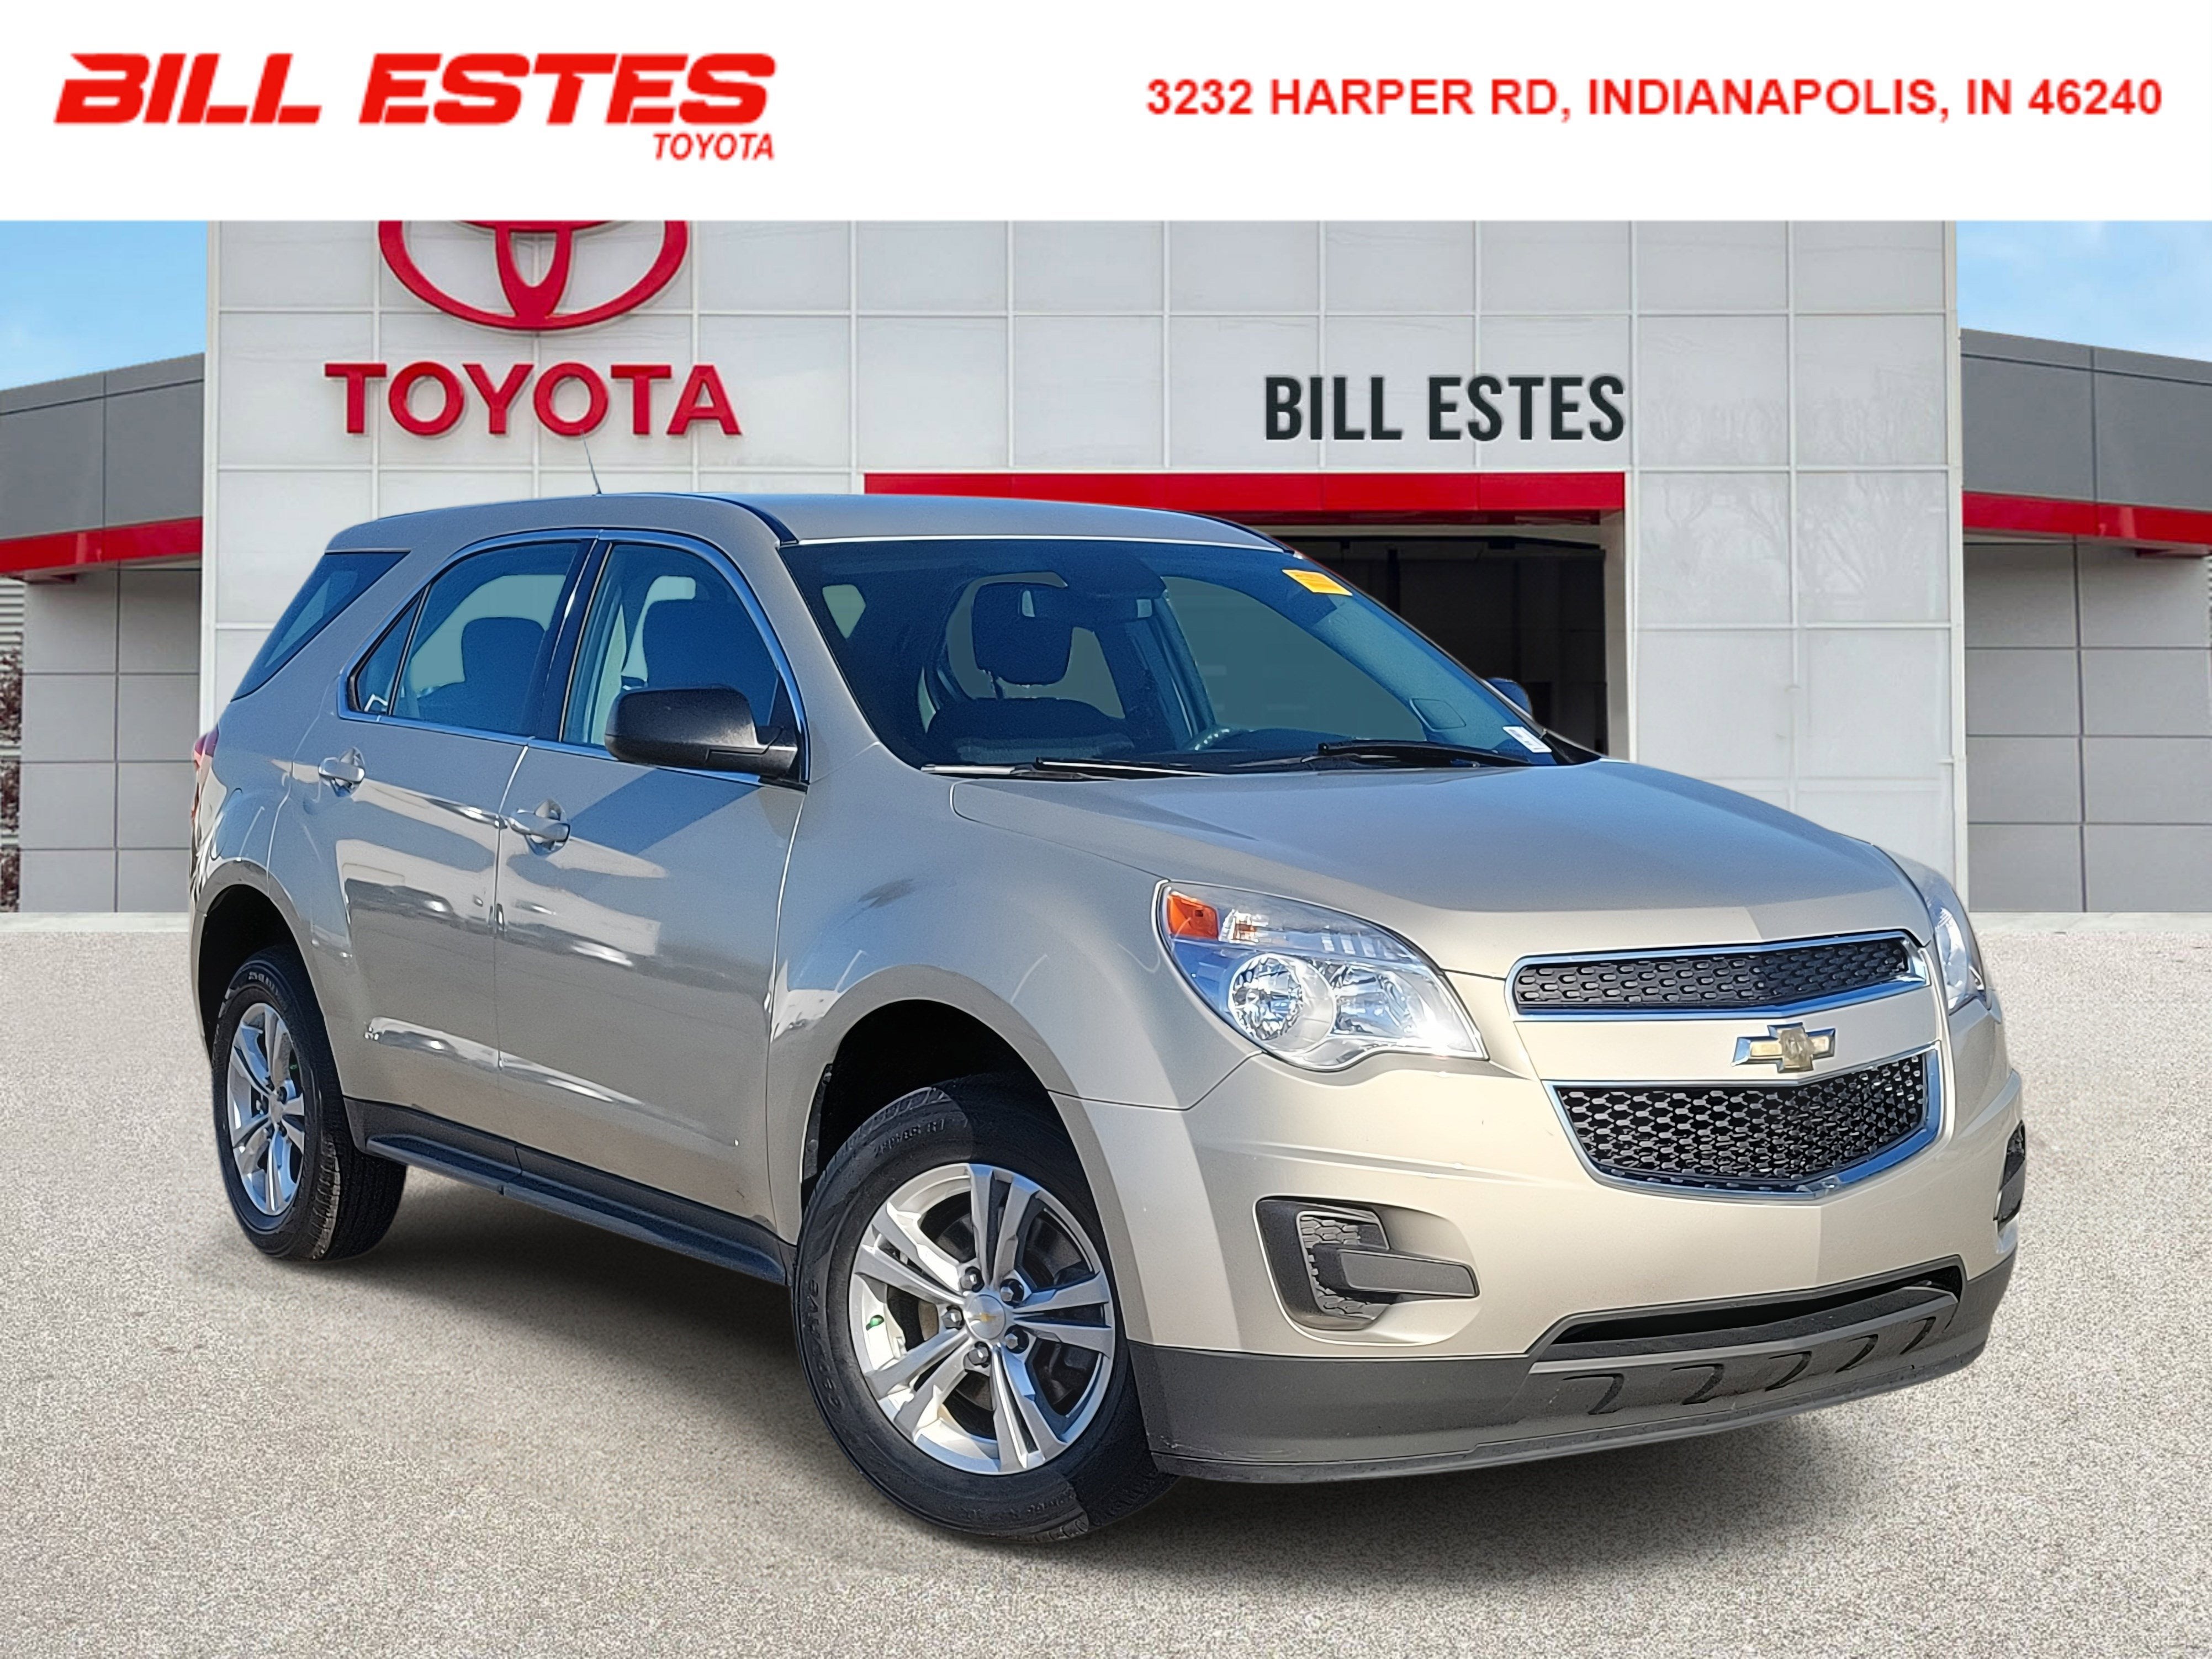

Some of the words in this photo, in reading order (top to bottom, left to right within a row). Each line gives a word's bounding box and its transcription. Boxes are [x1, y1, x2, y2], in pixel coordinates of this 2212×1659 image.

[325, 361, 740, 436] TOYOTA
[1266, 377, 1402, 439] BILL
[1429, 375, 1623, 441] ESTES
